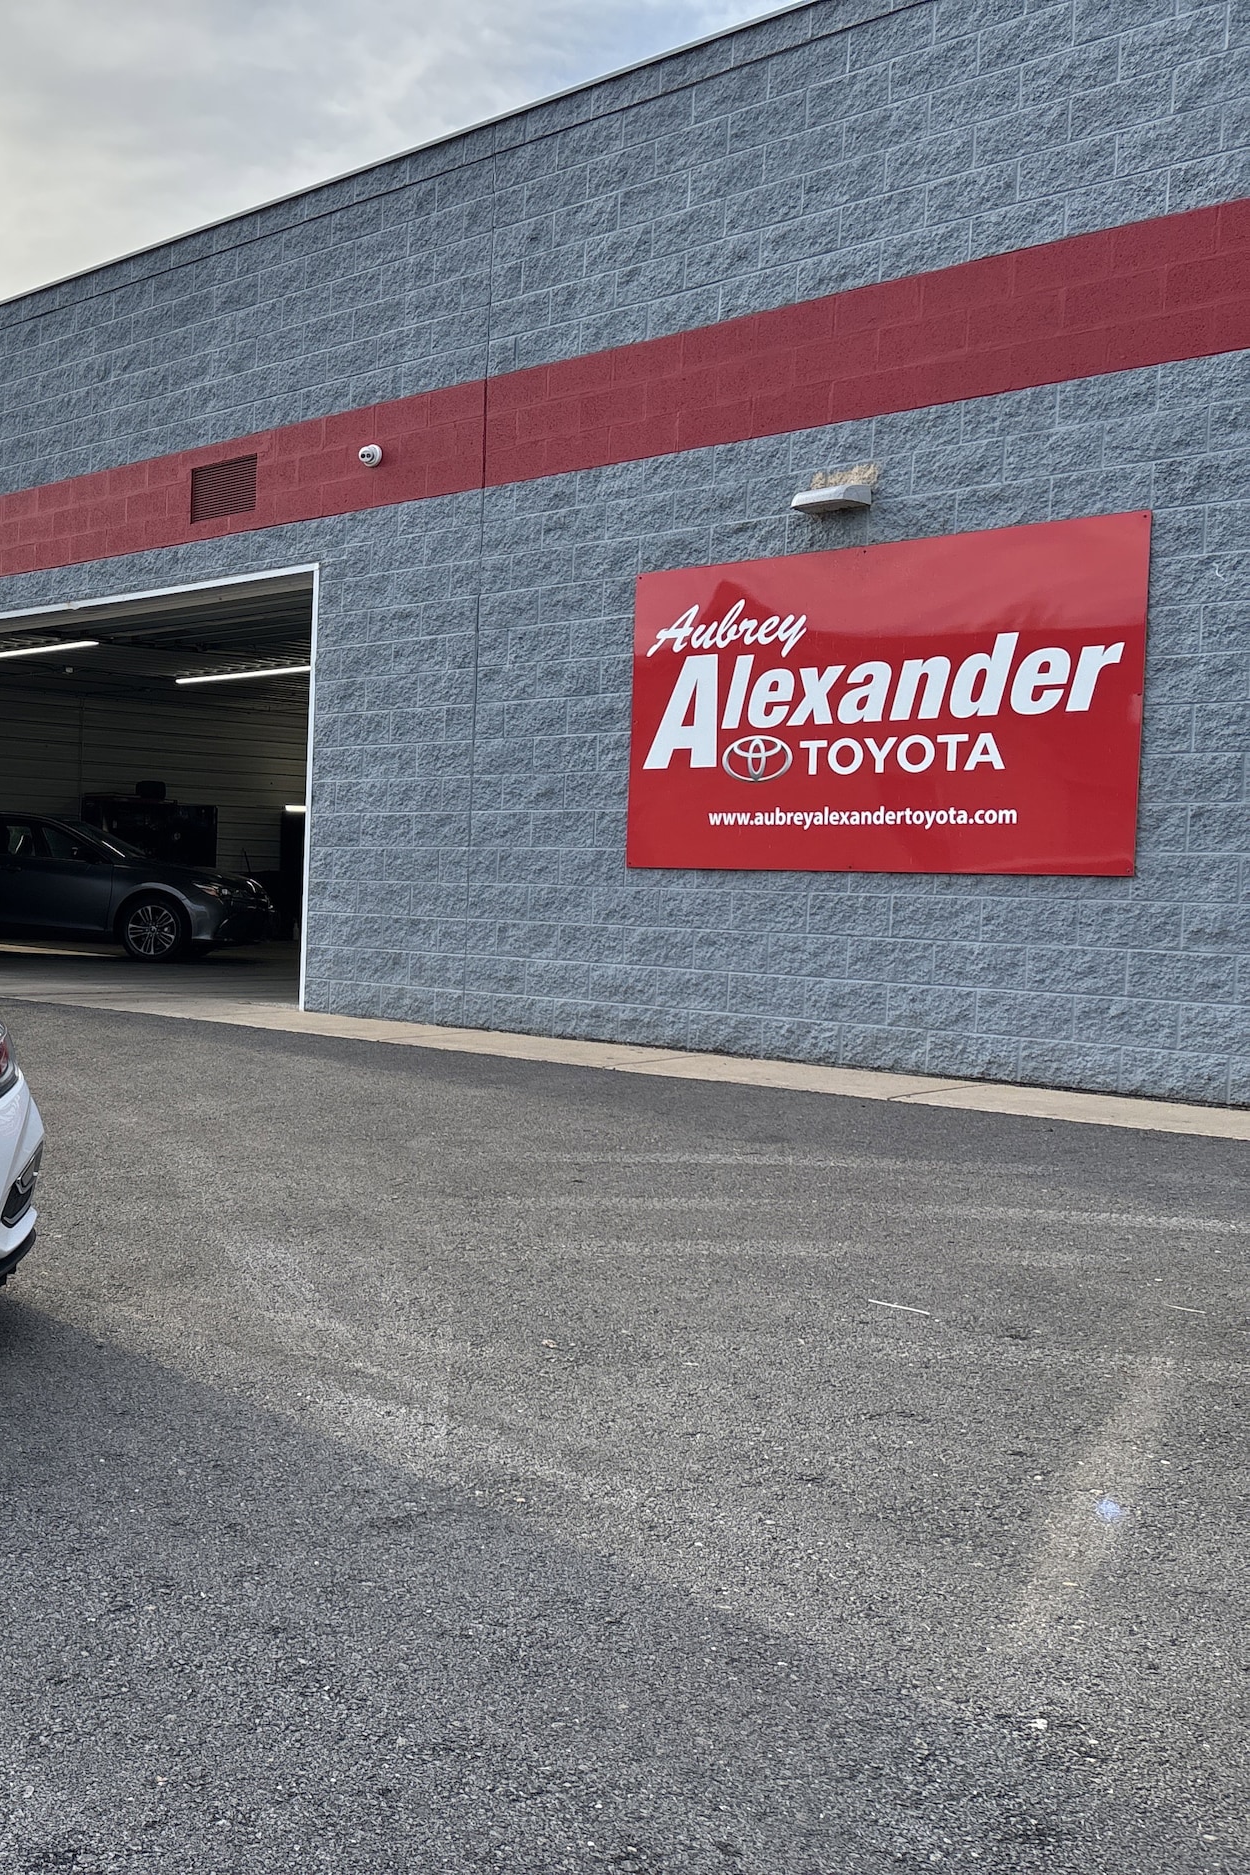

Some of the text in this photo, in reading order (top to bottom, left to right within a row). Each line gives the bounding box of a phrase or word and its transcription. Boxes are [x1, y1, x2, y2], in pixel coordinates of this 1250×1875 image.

[647, 599, 807, 658] Aubrey
[643, 632, 1125, 770] Alexander
[800, 732, 1006, 775] TOYOTA
[709, 805, 1017, 830] www.aubreyalexandertoyota.com
